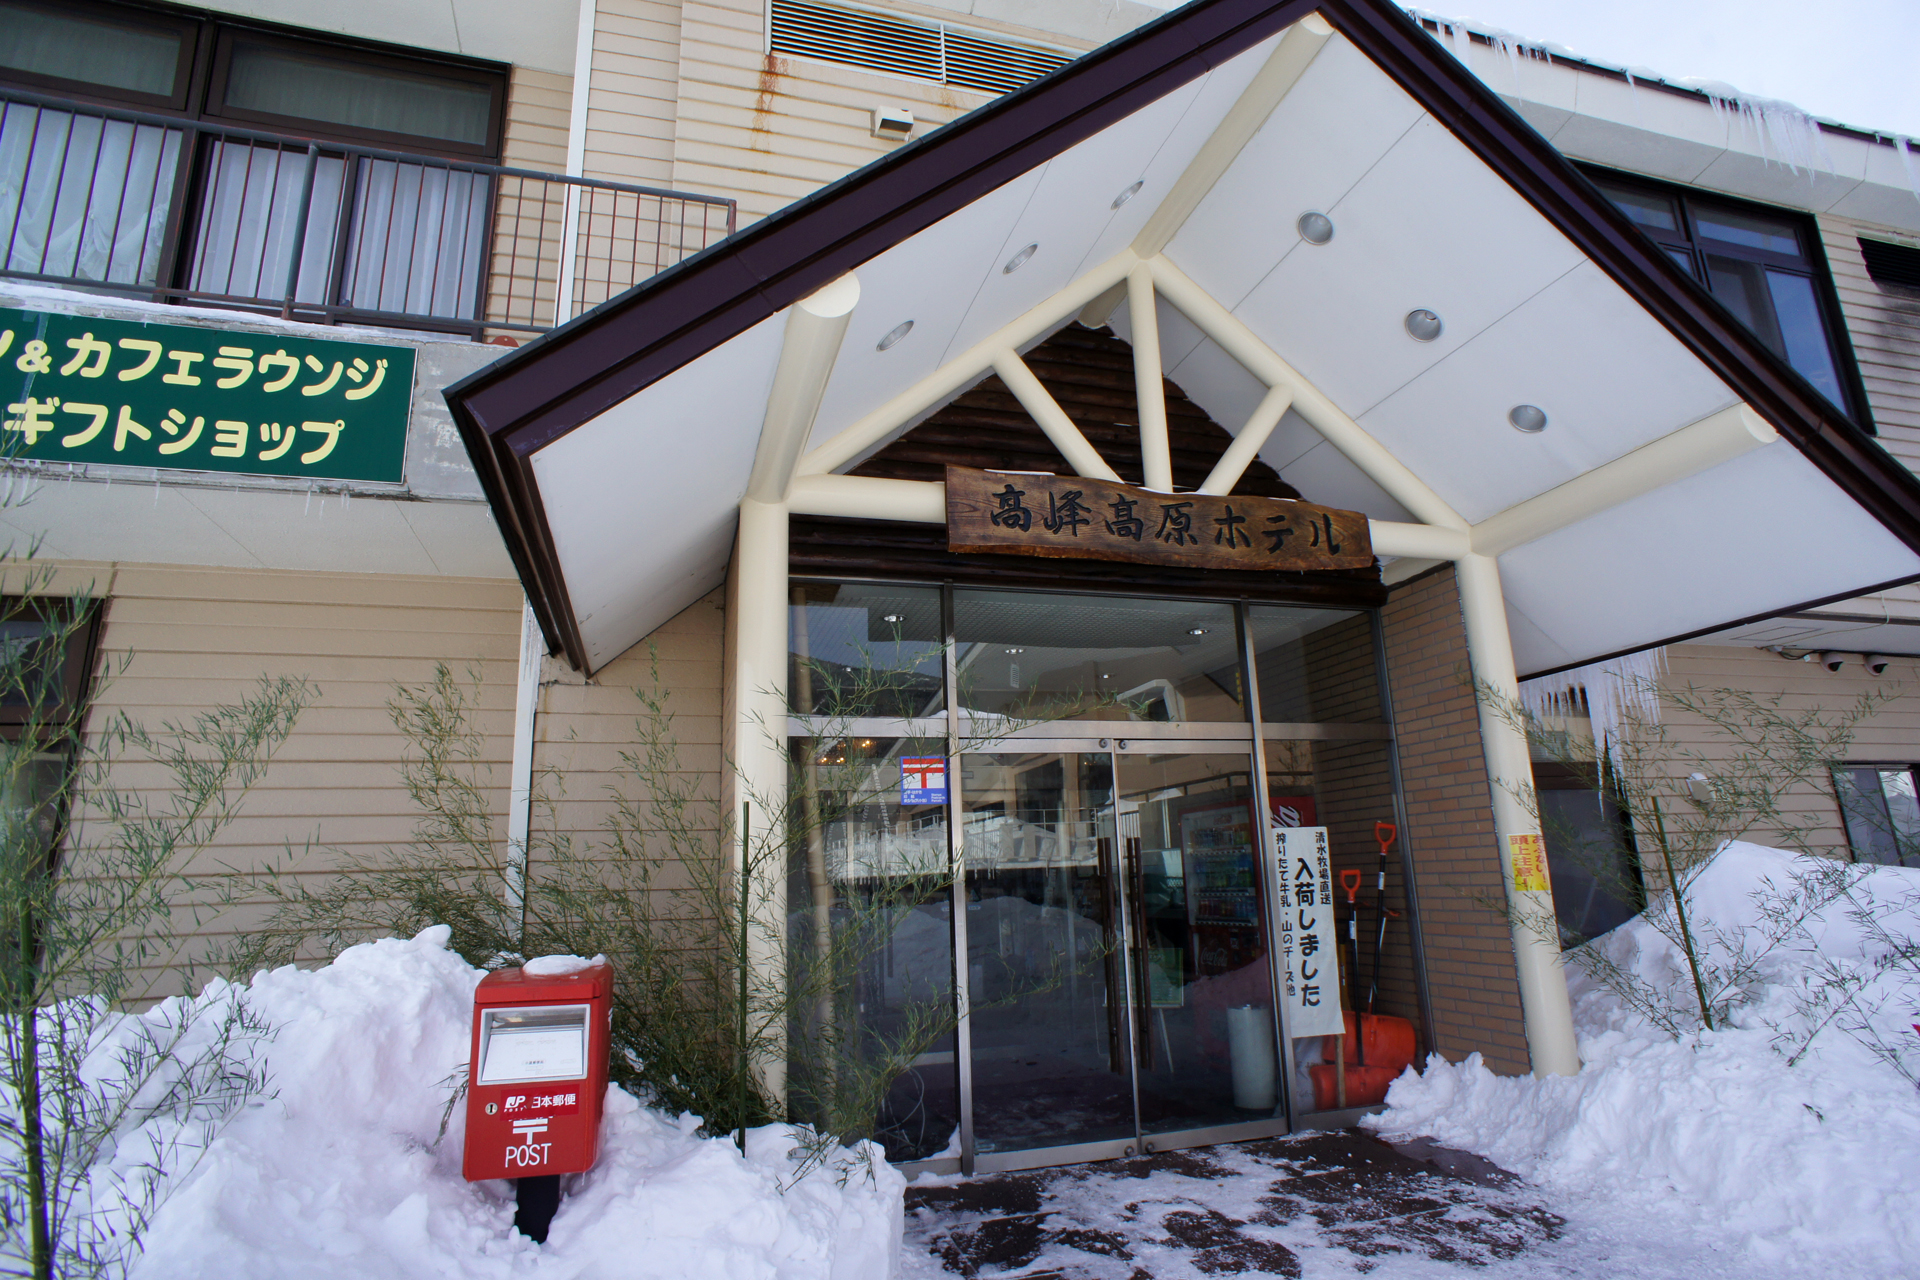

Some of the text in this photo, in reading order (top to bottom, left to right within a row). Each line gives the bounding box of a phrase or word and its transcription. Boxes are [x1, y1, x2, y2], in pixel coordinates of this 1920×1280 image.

[3, 397, 346, 464] ギフトショップ
[1315, 831, 1331, 905] 清水牧場直送
[1294, 857, 1321, 1007] 入荷しました
[531, 1093, 576, 1109] 日本郵便
[505, 1142, 552, 1168] POST
